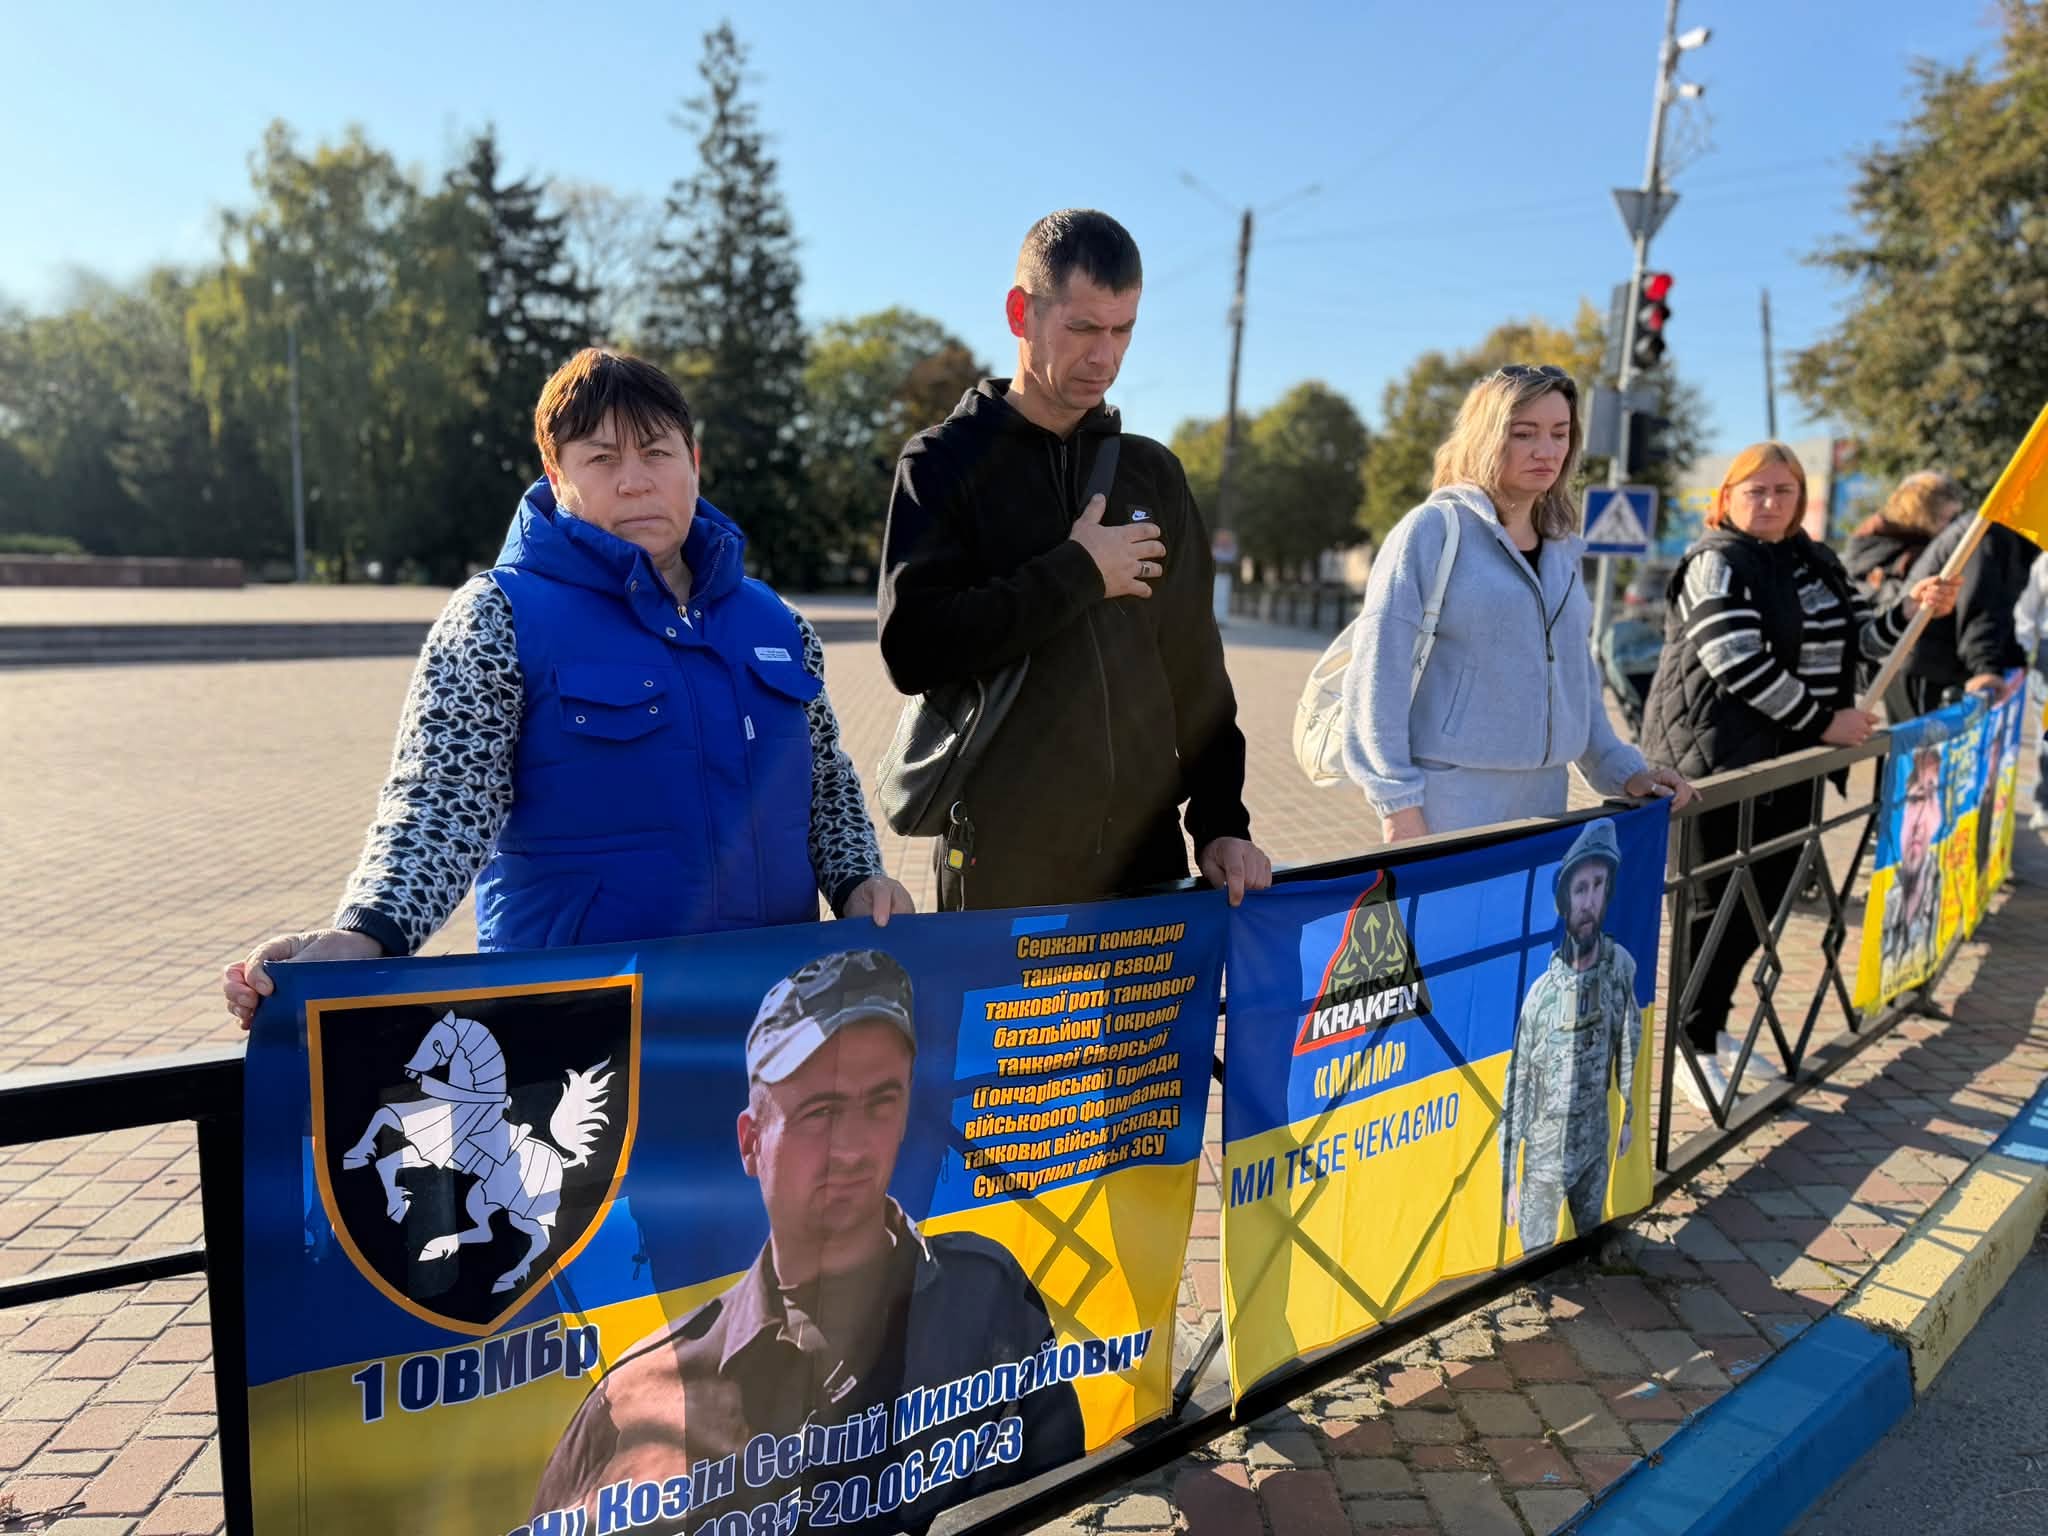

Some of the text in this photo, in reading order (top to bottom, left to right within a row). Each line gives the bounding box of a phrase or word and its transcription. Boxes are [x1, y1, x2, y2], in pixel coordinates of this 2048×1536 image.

[1016, 921, 1184, 959] Сержант командир
[1021, 950, 1173, 988] танкового взводу
[984, 974, 1195, 1020] танкової роти танкового
[1311, 983, 1419, 1039] KRAKEN
[992, 999, 1182, 1048] батальйону 1 окремої
[996, 1045, 1081, 1077] танкової
[963, 1104, 1076, 1140] військового
[962, 1138, 1050, 1170] танкових
[1052, 1124, 1109, 1156] військ
[971, 1133, 1166, 1198] Сухопутних військ ЗСУ
[1230, 1091, 1458, 1207] МИ ТЕБЕ ЧЕКАЄМО
[595, 1452, 734, 1536] Козін
[744, 1402, 887, 1487] Сергій
[892, 1327, 1153, 1444] Миколайович
